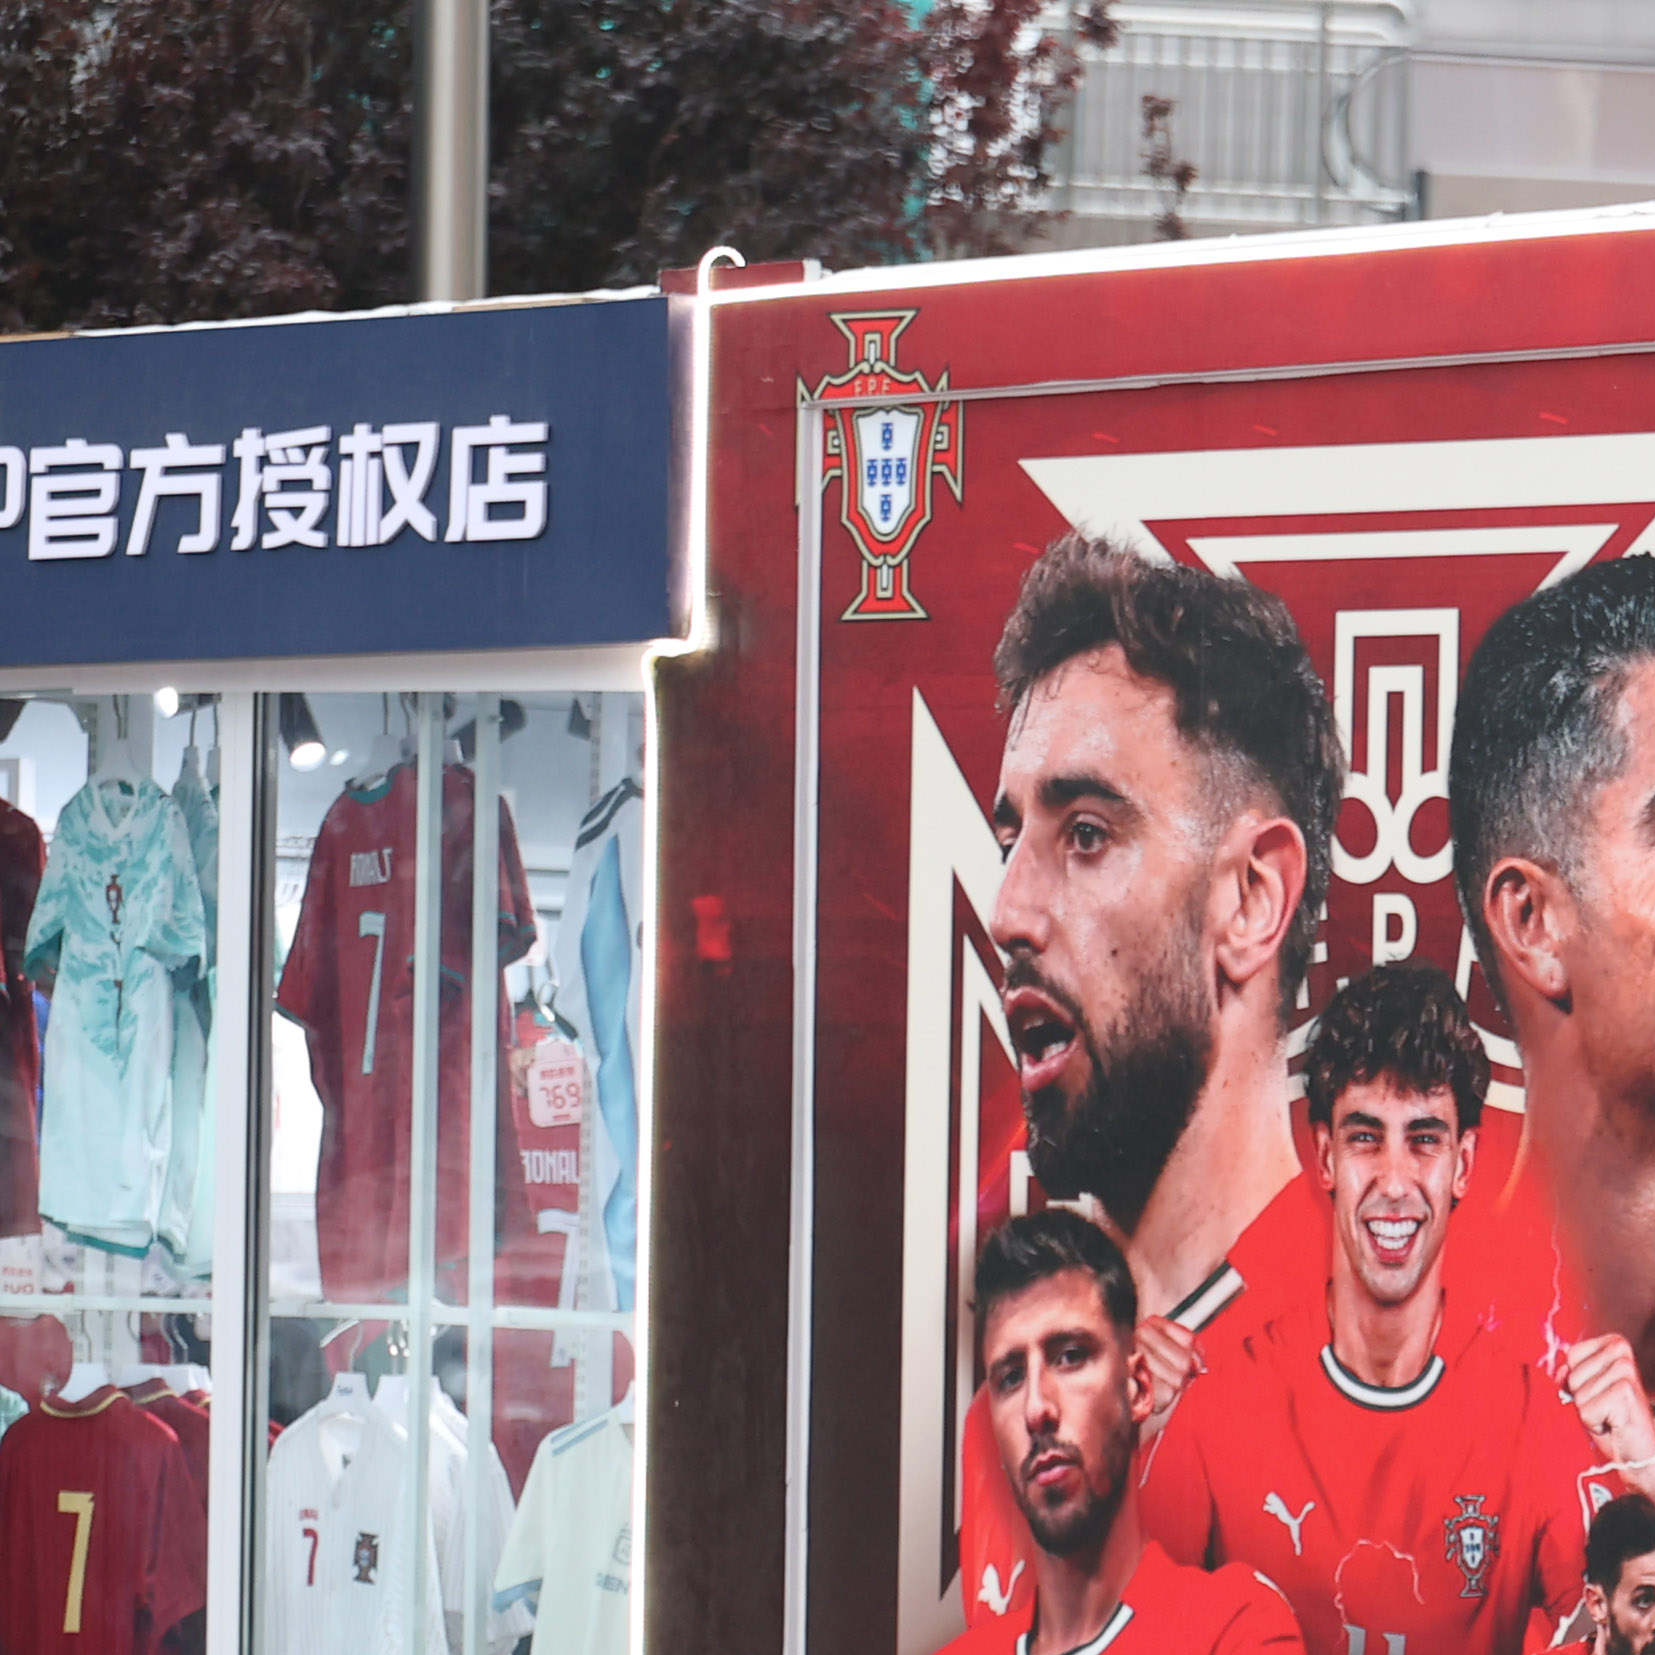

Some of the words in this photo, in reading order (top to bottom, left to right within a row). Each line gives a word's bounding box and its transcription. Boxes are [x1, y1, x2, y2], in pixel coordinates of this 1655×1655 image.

[358, 910, 387, 1075] 7
[58, 1491, 95, 1633] 7
[303, 1527, 320, 1587] 7
